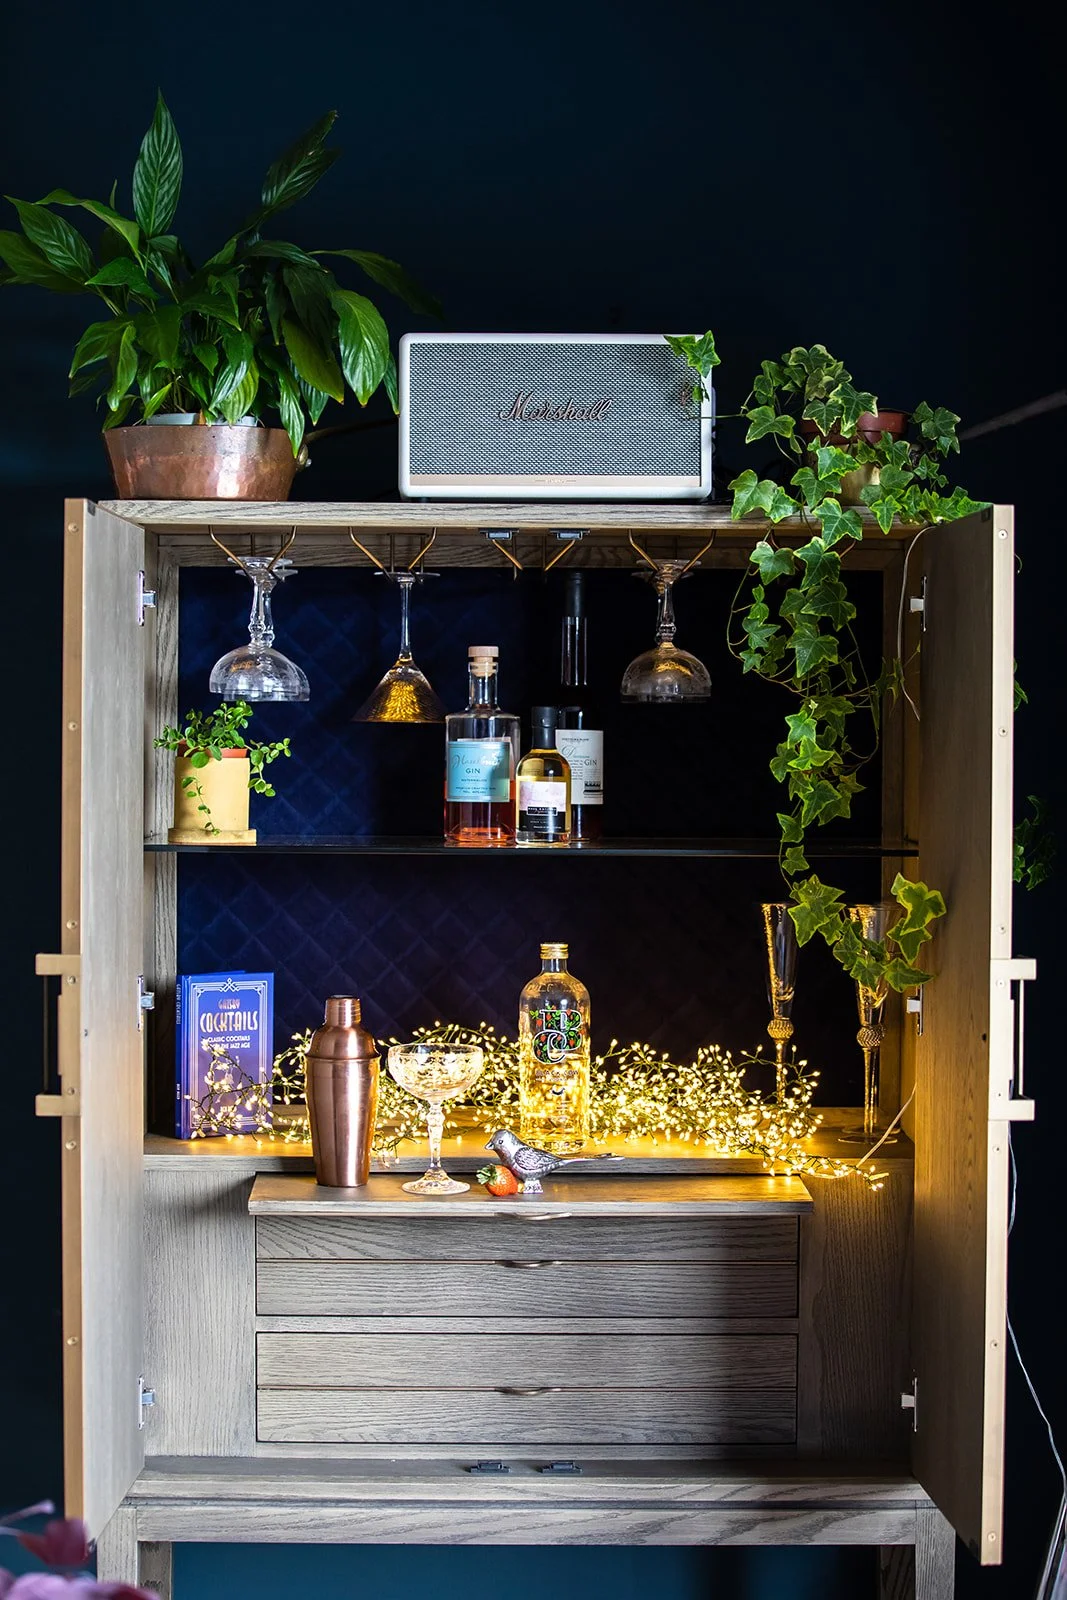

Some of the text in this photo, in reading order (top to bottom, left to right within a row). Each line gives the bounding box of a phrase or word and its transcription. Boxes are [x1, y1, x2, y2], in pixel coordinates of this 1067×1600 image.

[499, 390, 613, 421] Marshall
[218, 998, 240, 1010] GATSBY
[199, 1011, 258, 1033] COCKTAILS
